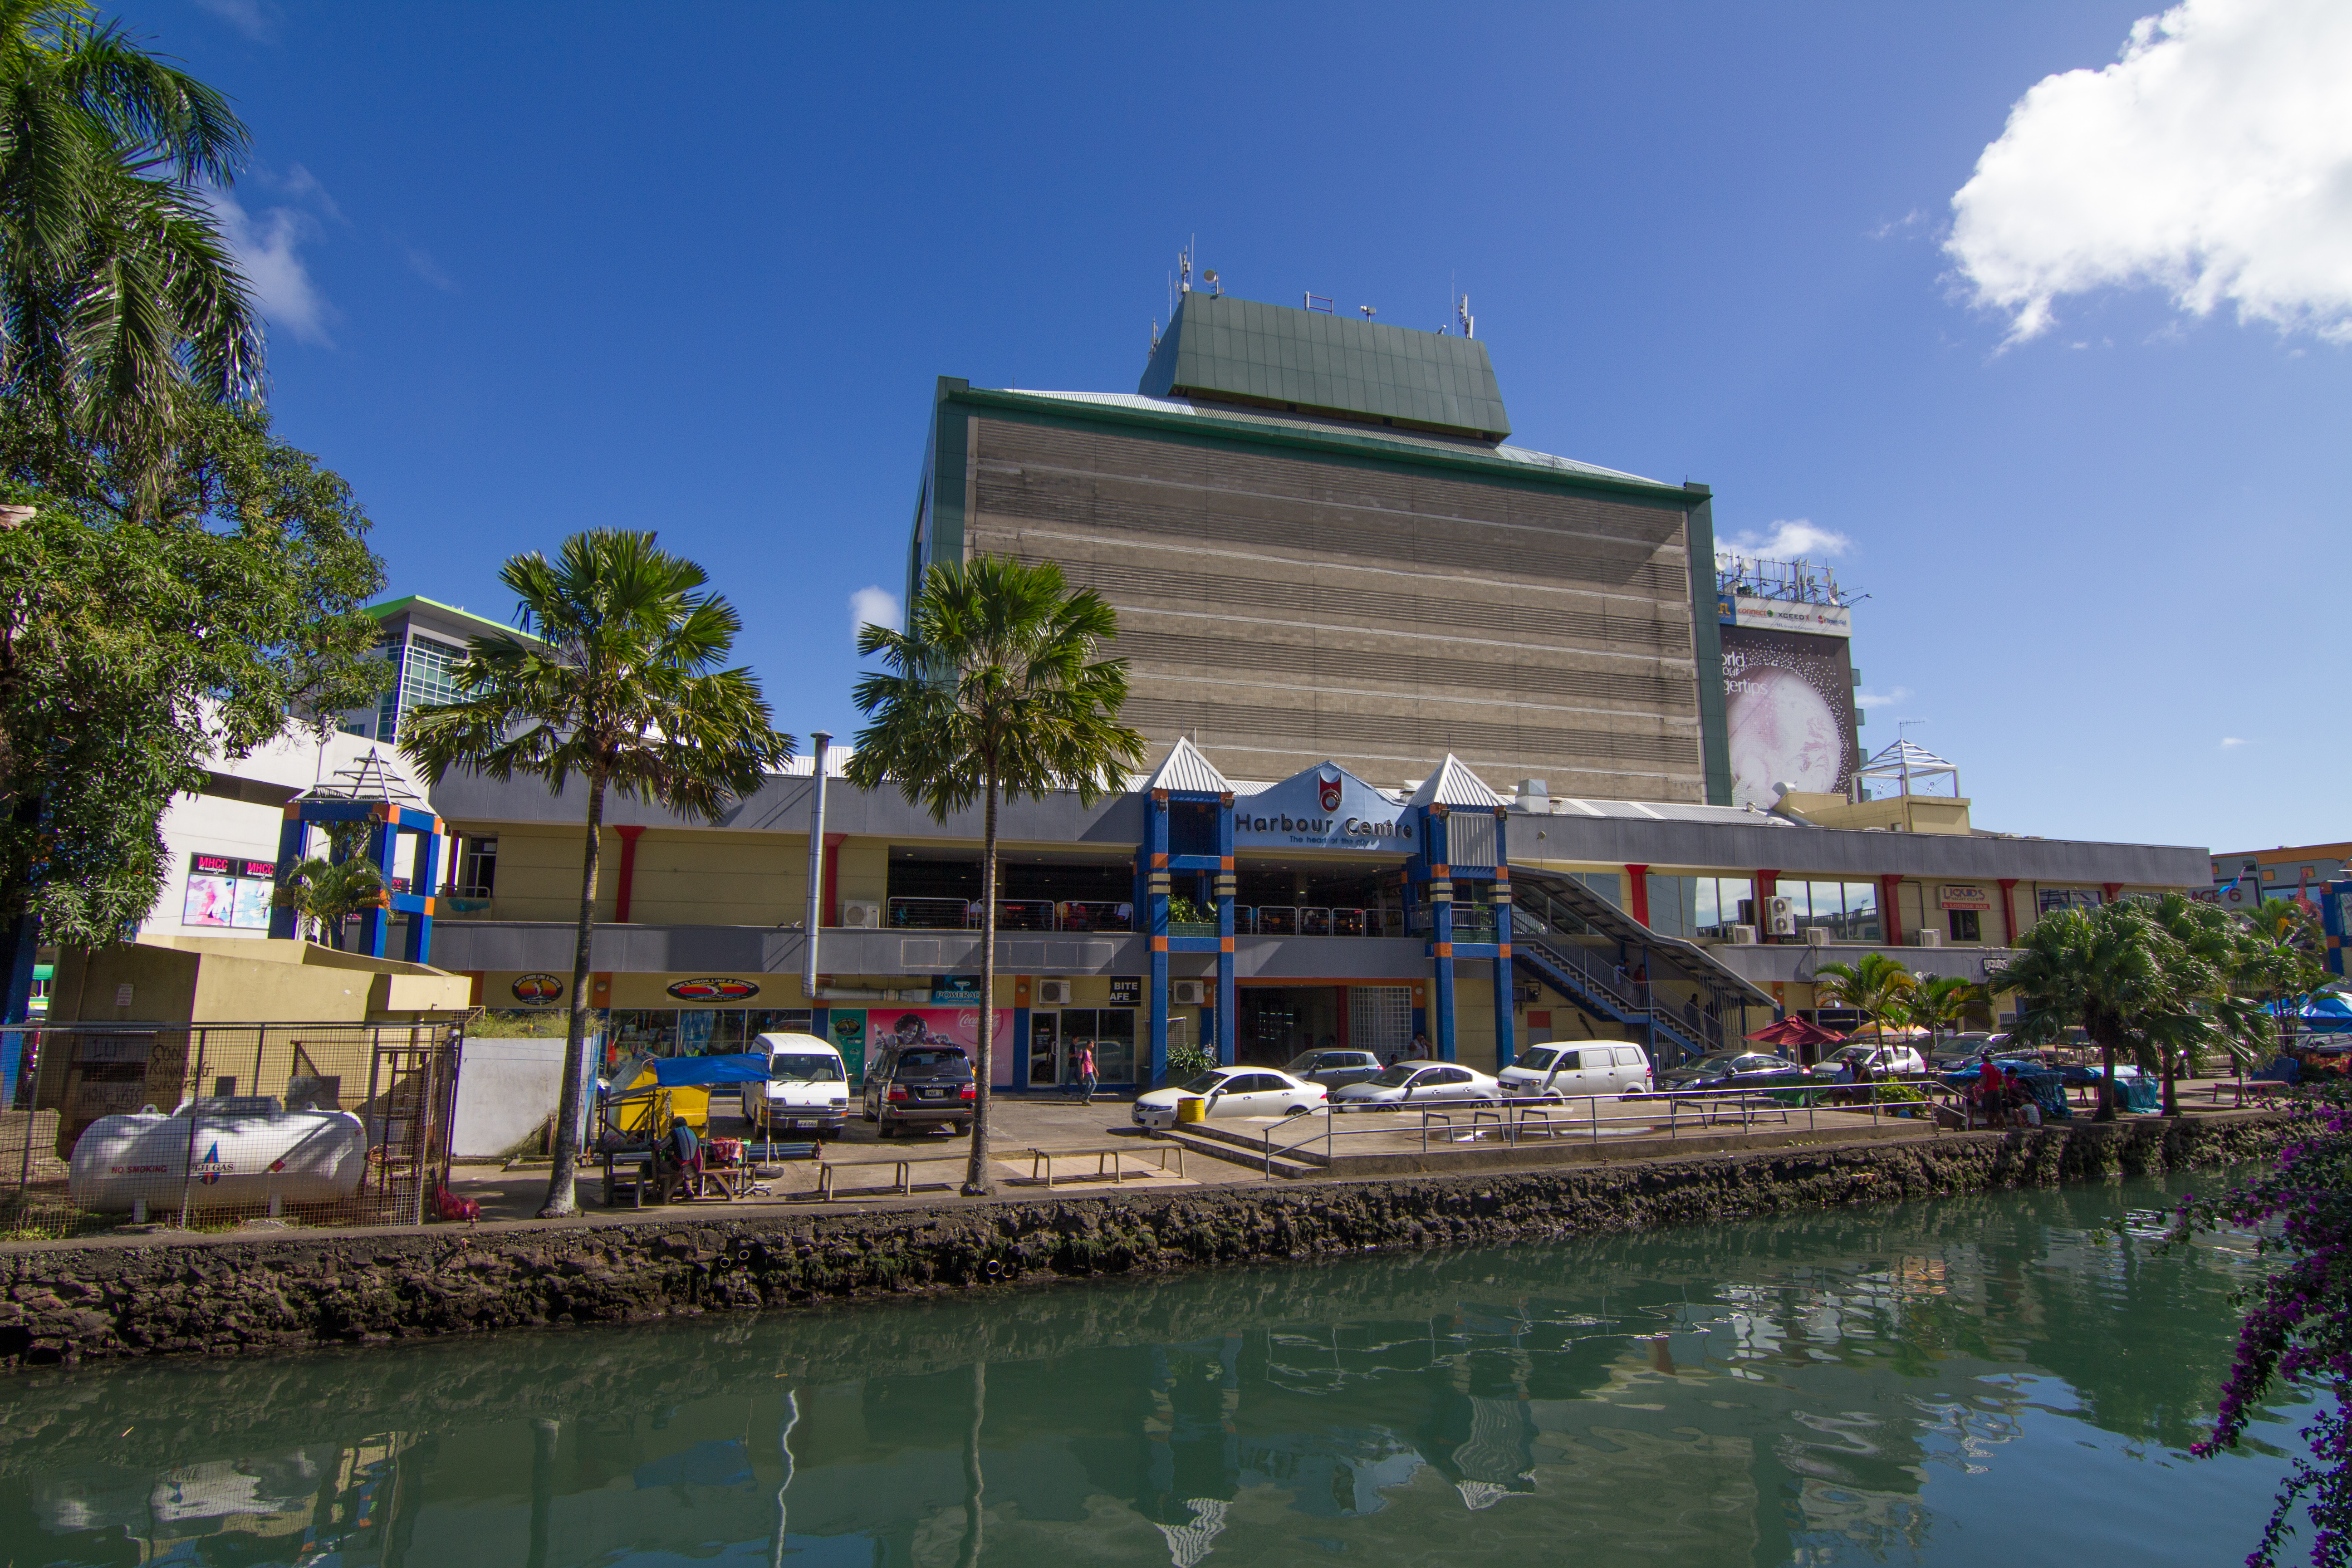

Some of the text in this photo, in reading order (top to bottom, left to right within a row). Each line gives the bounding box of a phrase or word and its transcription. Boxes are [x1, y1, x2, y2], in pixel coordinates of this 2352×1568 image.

[1738, 608, 1767, 616] connect
[1721, 651, 1745, 667] orld
[1723, 667, 1740, 676] our
[1723, 679, 1768, 697] gertips
[1235, 813, 1412, 838] Harbour Centre
[199, 857, 228, 869] MHCC
[247, 862, 274, 874] MHCC
[392, 879, 402, 889] CC
[2191, 888, 2242, 903] AGE 6
[671, 981, 690, 990] BOB'S
[734, 980, 755, 989] SINKER
[1109, 993, 1129, 1001] AFE
[127, 1165, 167, 1173] SMOKING
